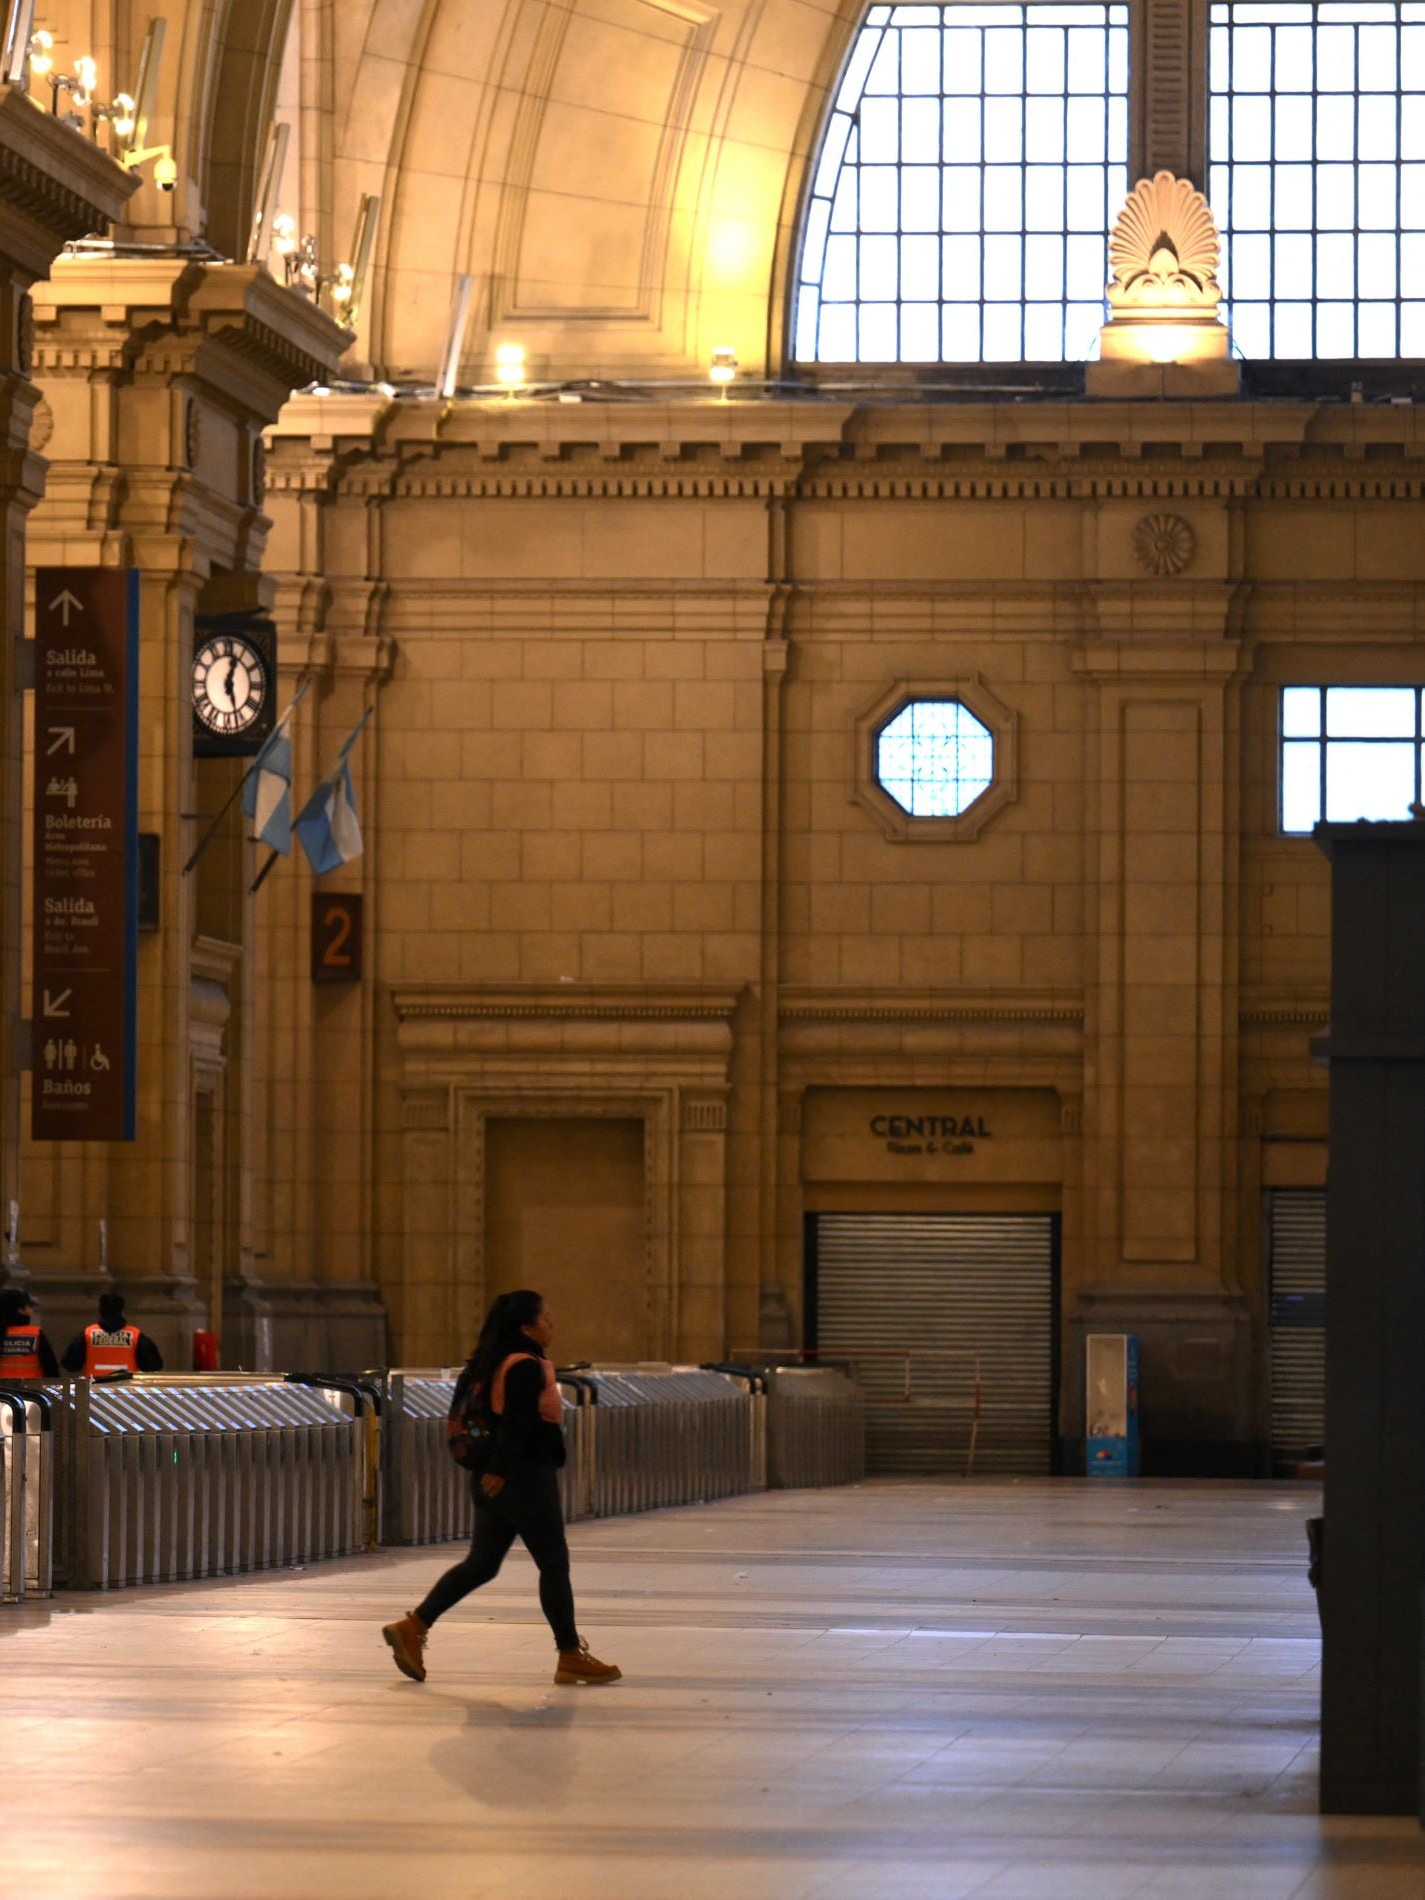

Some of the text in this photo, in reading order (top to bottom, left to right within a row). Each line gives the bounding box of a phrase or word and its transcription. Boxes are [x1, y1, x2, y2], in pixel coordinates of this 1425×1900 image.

[46, 648, 97, 666] Salida
[45, 814, 112, 829] Boletería
[44, 897, 95, 914] Salida
[323, 906, 352, 966] 2
[42, 1078, 92, 1095] Baños
[870, 1114, 992, 1137] CENTRAL
